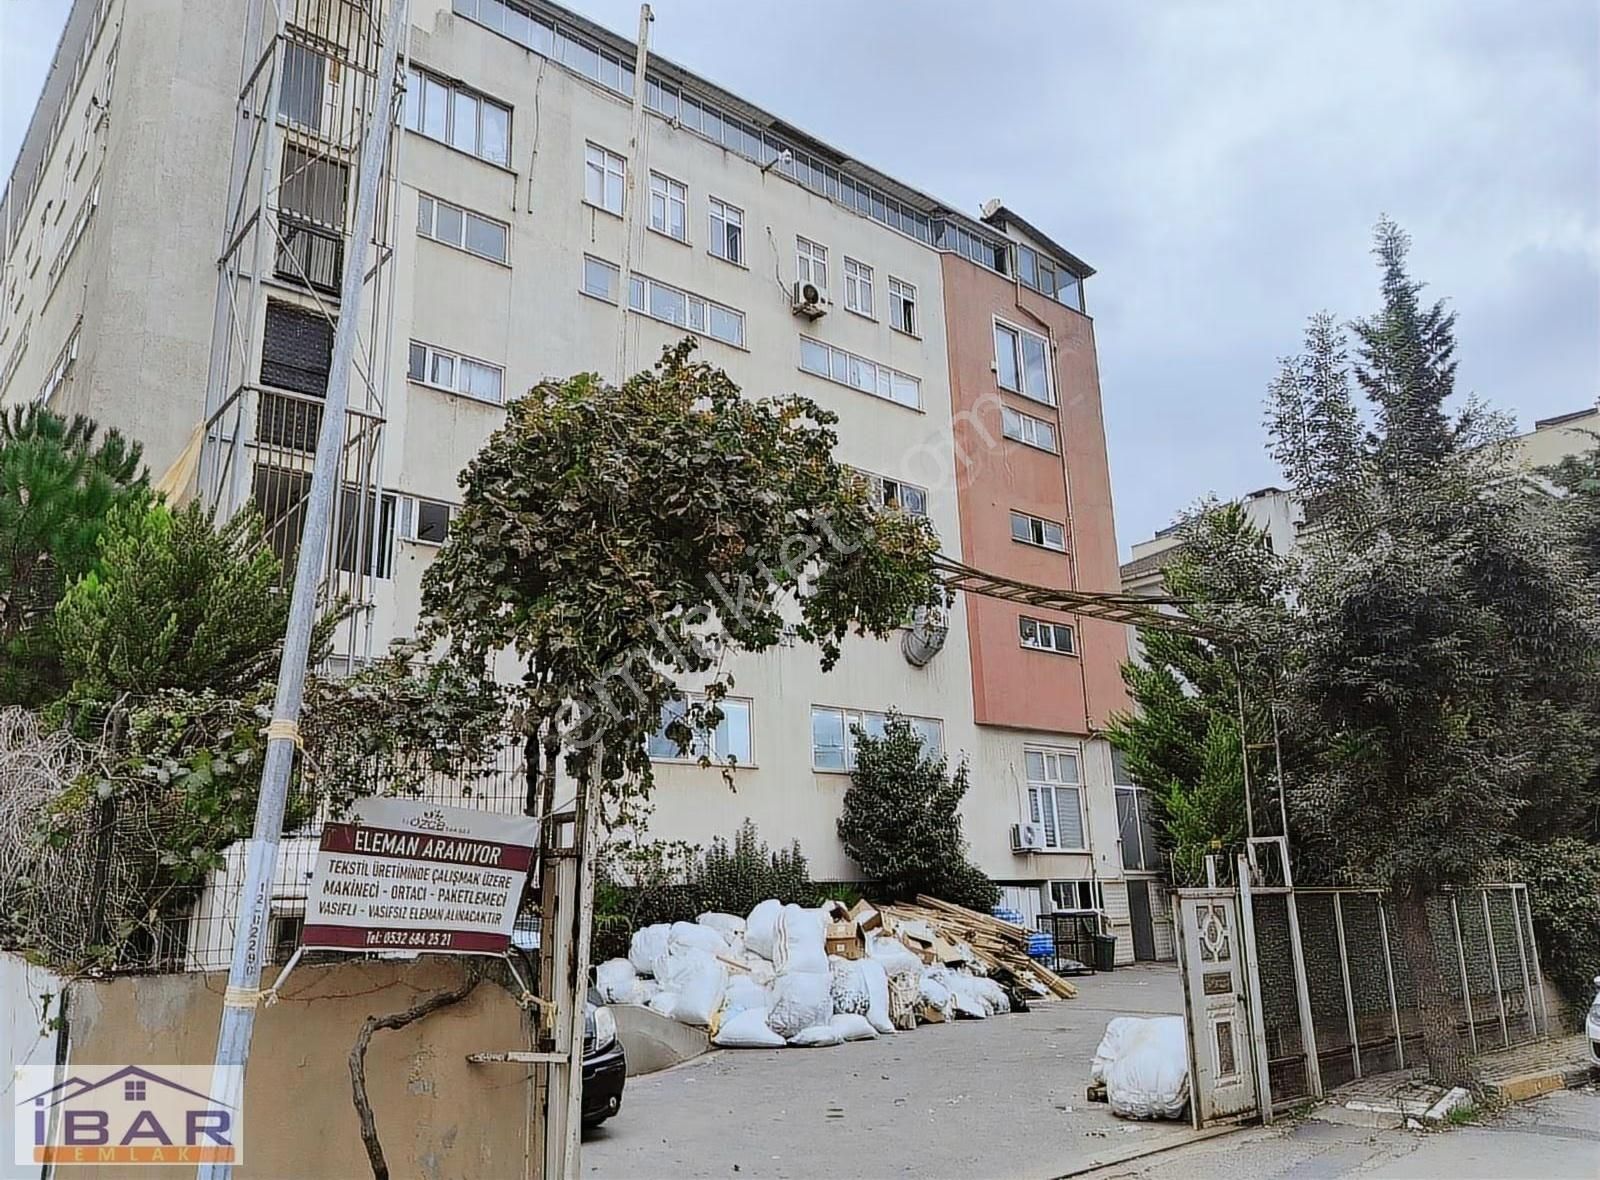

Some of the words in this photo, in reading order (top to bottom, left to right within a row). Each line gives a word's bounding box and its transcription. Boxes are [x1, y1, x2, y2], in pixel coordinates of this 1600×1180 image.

[355, 830, 420, 857] ELEMAN
[421, 838, 501, 865] ARANIYOR
[328, 859, 369, 877] TEKSTİL
[372, 861, 430, 881] ÜRETİMİNDE
[432, 868, 481, 886] ÇALIŞMAK
[482, 871, 512, 889] ÜZERE
[323, 879, 380, 898] MAKİNECİ
[391, 885, 427, 900] ORTACI
[438, 887, 507, 907] PAKETLEMECİ
[319, 901, 357, 916] VASIFLI
[409, 906, 444, 920] ELEMAN
[444, 908, 503, 925] ALINACAKTIR
[383, 931, 408, 945] 0532
[427, 932, 440, 945] 25
